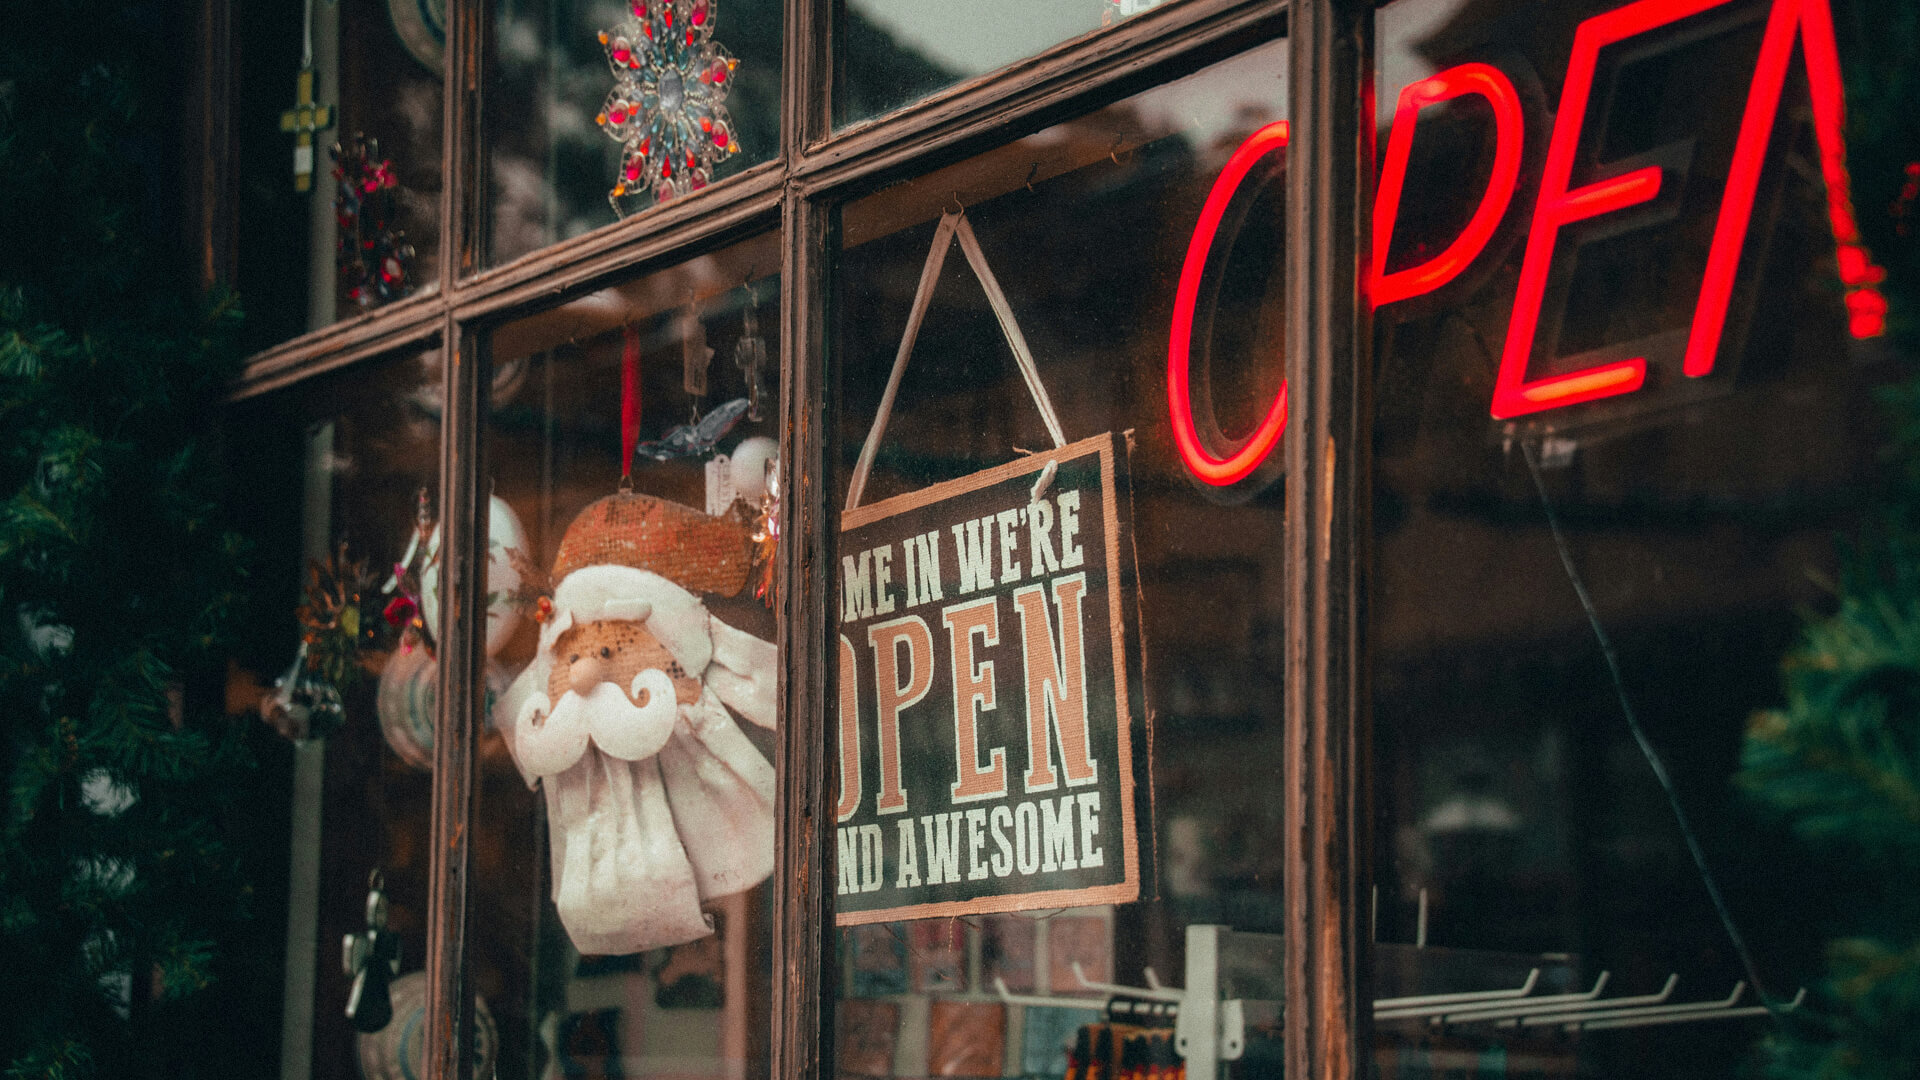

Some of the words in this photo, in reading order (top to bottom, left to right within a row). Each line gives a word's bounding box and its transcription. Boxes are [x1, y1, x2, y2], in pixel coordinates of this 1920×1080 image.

[840, 544, 895, 624] ME
[903, 530, 944, 608] IN
[952, 489, 1084, 595] WE'RE
[837, 823, 884, 895] ND
[895, 791, 1104, 889] AWESOME
